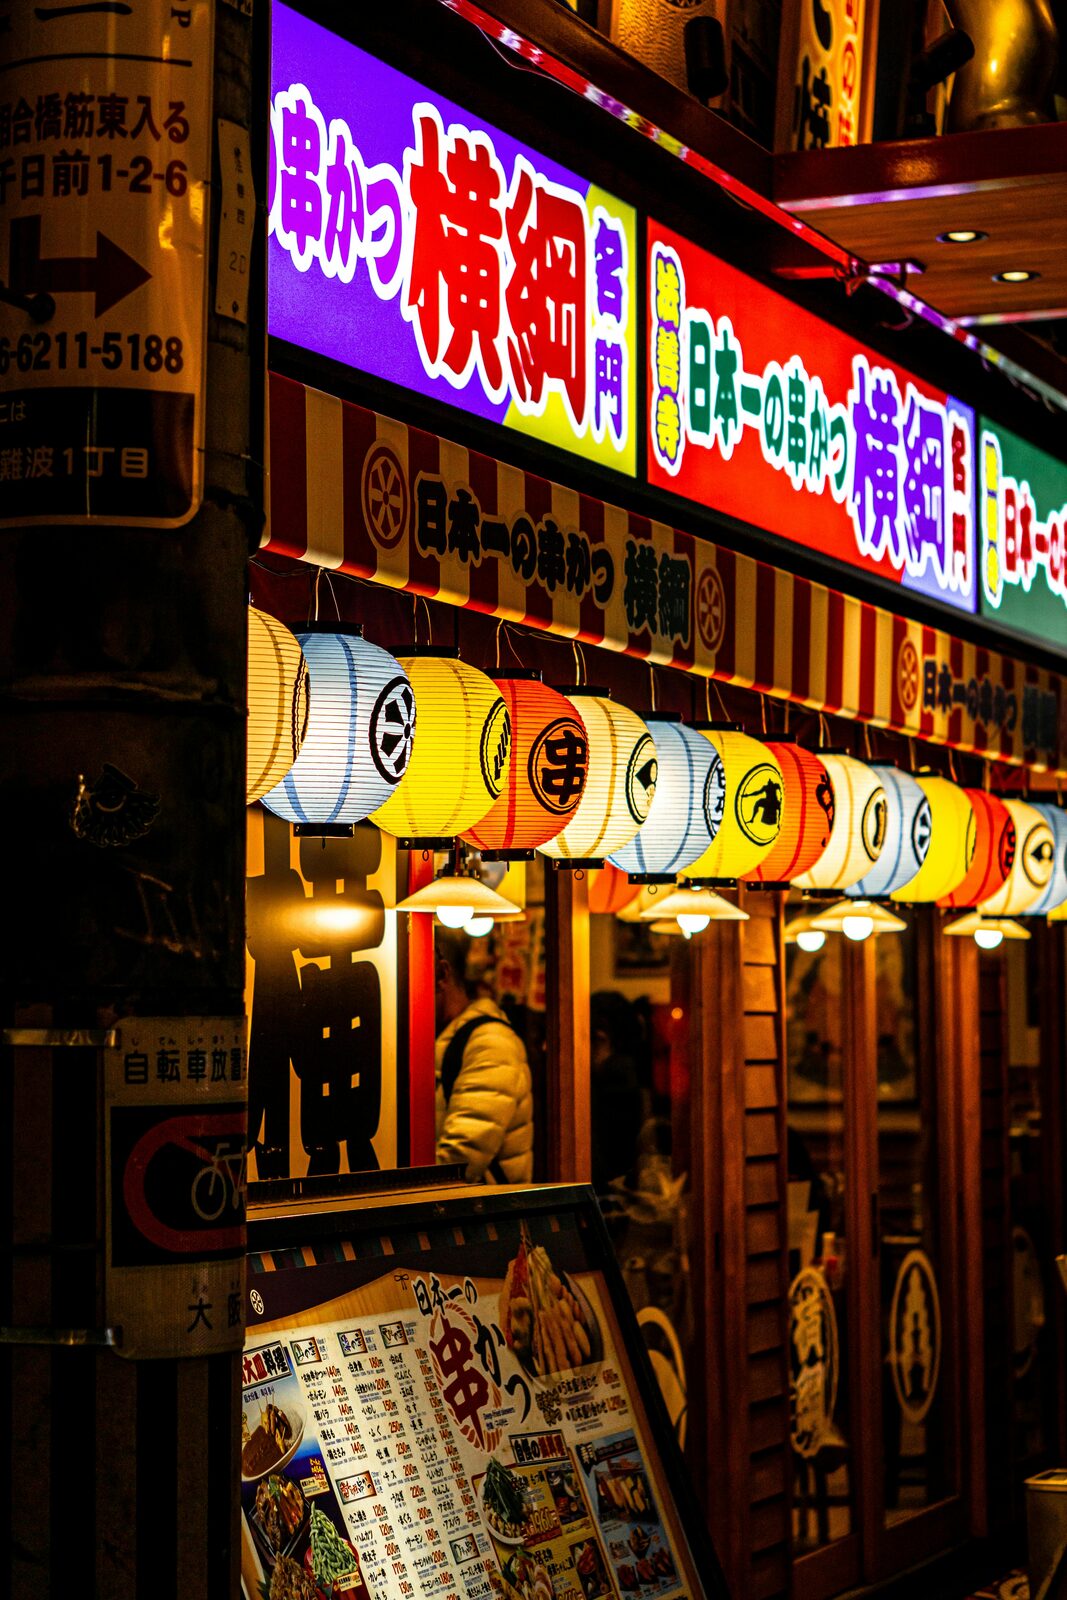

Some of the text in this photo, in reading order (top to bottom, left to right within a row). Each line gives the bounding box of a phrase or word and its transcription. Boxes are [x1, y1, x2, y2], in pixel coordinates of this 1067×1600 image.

[268, 92, 400, 290] 串かつ
[0, 446, 150, 481] 難波1丁目
[416, 479, 615, 605] 日本一の串かつ
[1003, 485, 1067, 588] 日本一の
[541, 730, 587, 805] 串
[125, 1047, 246, 1085] 自転車放置
[413, 1276, 477, 1316] 日本一の
[242, 1346, 288, 1386] 大皿料理
